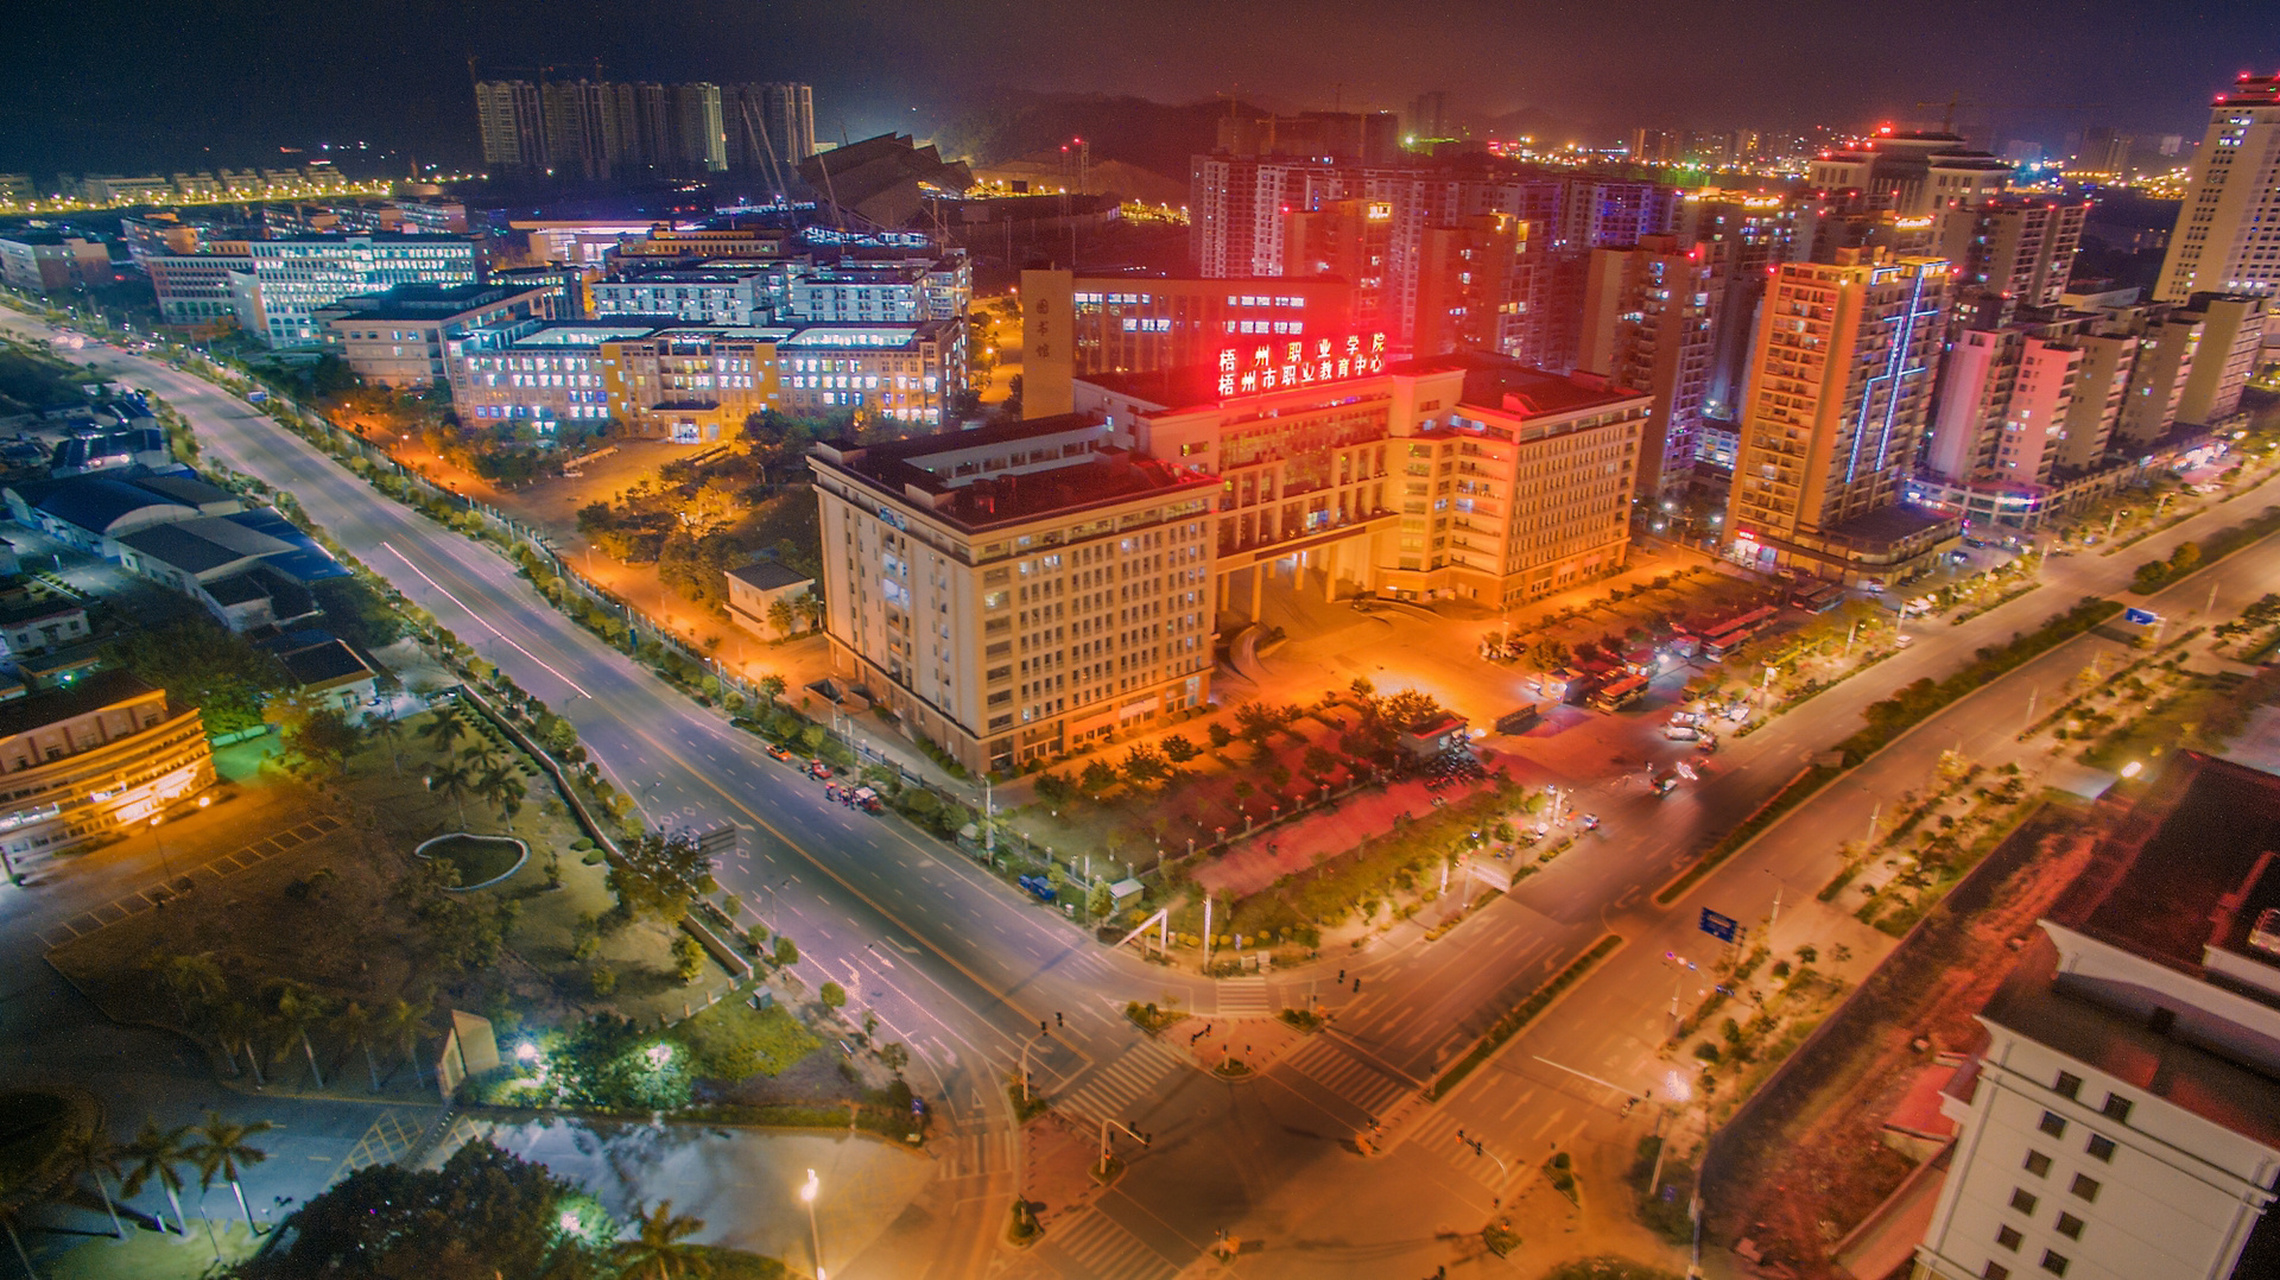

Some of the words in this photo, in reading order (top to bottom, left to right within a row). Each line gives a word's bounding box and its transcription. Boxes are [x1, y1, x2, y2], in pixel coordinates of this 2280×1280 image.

[1218, 332, 1386, 372] 梧州职业学院
[1217, 353, 1385, 397] 梧州市职业教育中心
